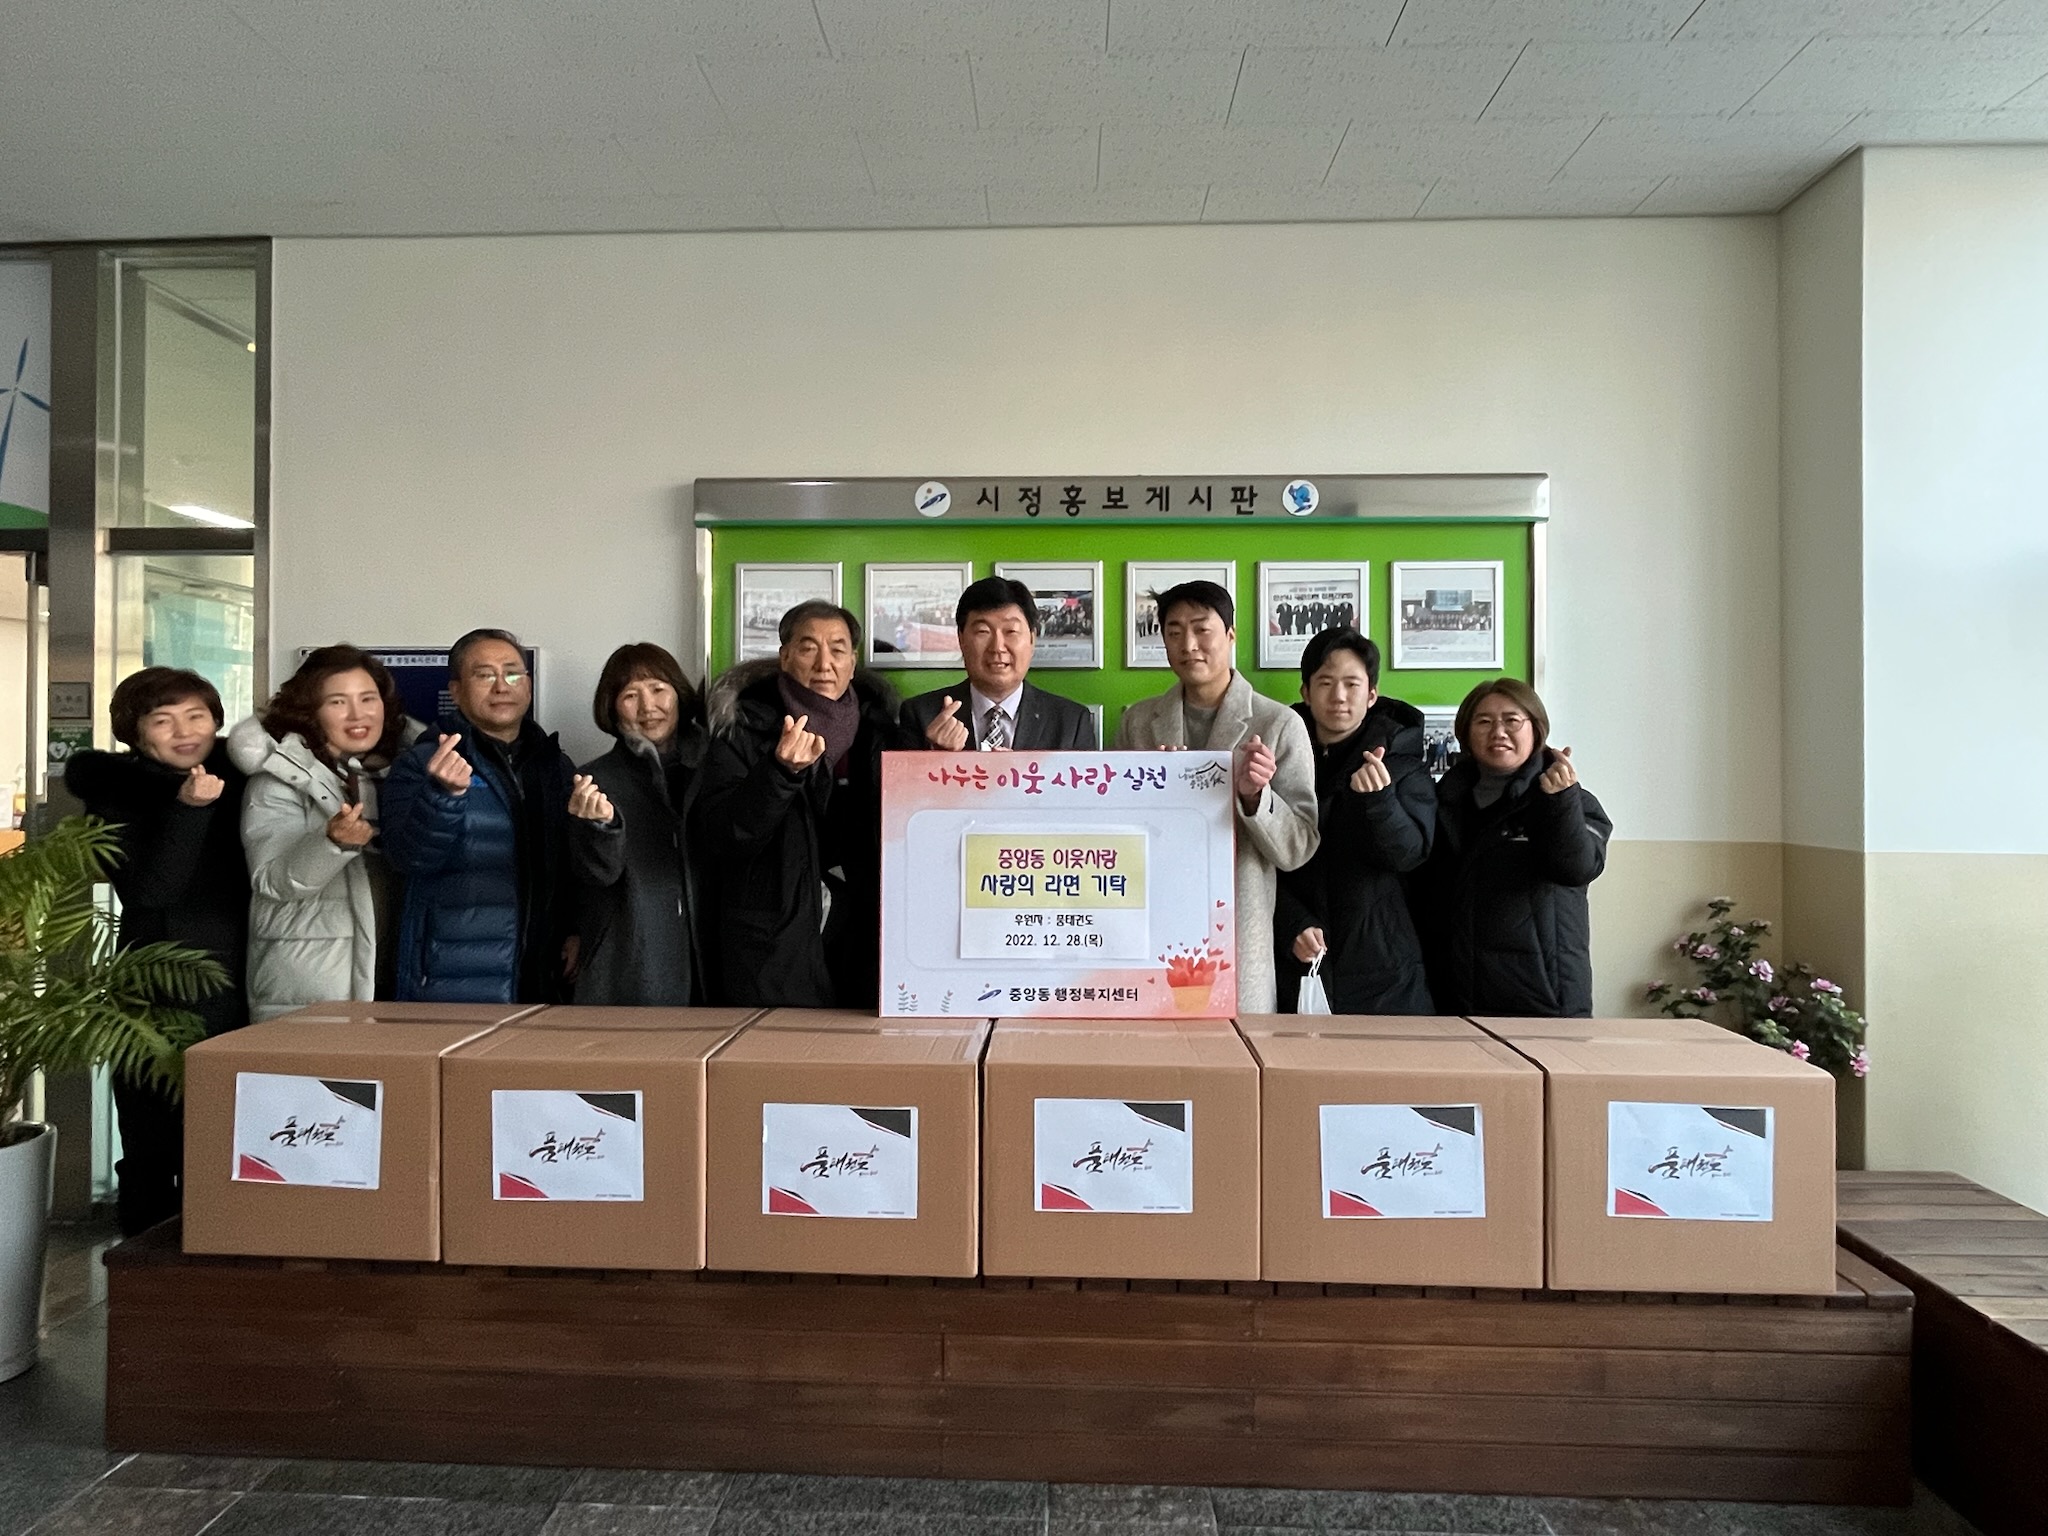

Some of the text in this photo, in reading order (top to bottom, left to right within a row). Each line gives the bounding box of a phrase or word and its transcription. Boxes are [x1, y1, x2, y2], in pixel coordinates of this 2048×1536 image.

[976, 484, 1258, 517] 시정홍보게시판
[928, 765, 989, 790] 나누는
[997, 761, 1045, 794] 이웃
[1051, 763, 1117, 795] 사랑
[1123, 766, 1167, 791] 실천
[998, 848, 1118, 870] 중앙동 이웃사랑
[980, 874, 1127, 897] 사랑의 라면 기탁
[1005, 934, 1103, 947] 2022. 12. 28.(목)
[1009, 988, 1139, 1002] 중앙동 행정복지센터
